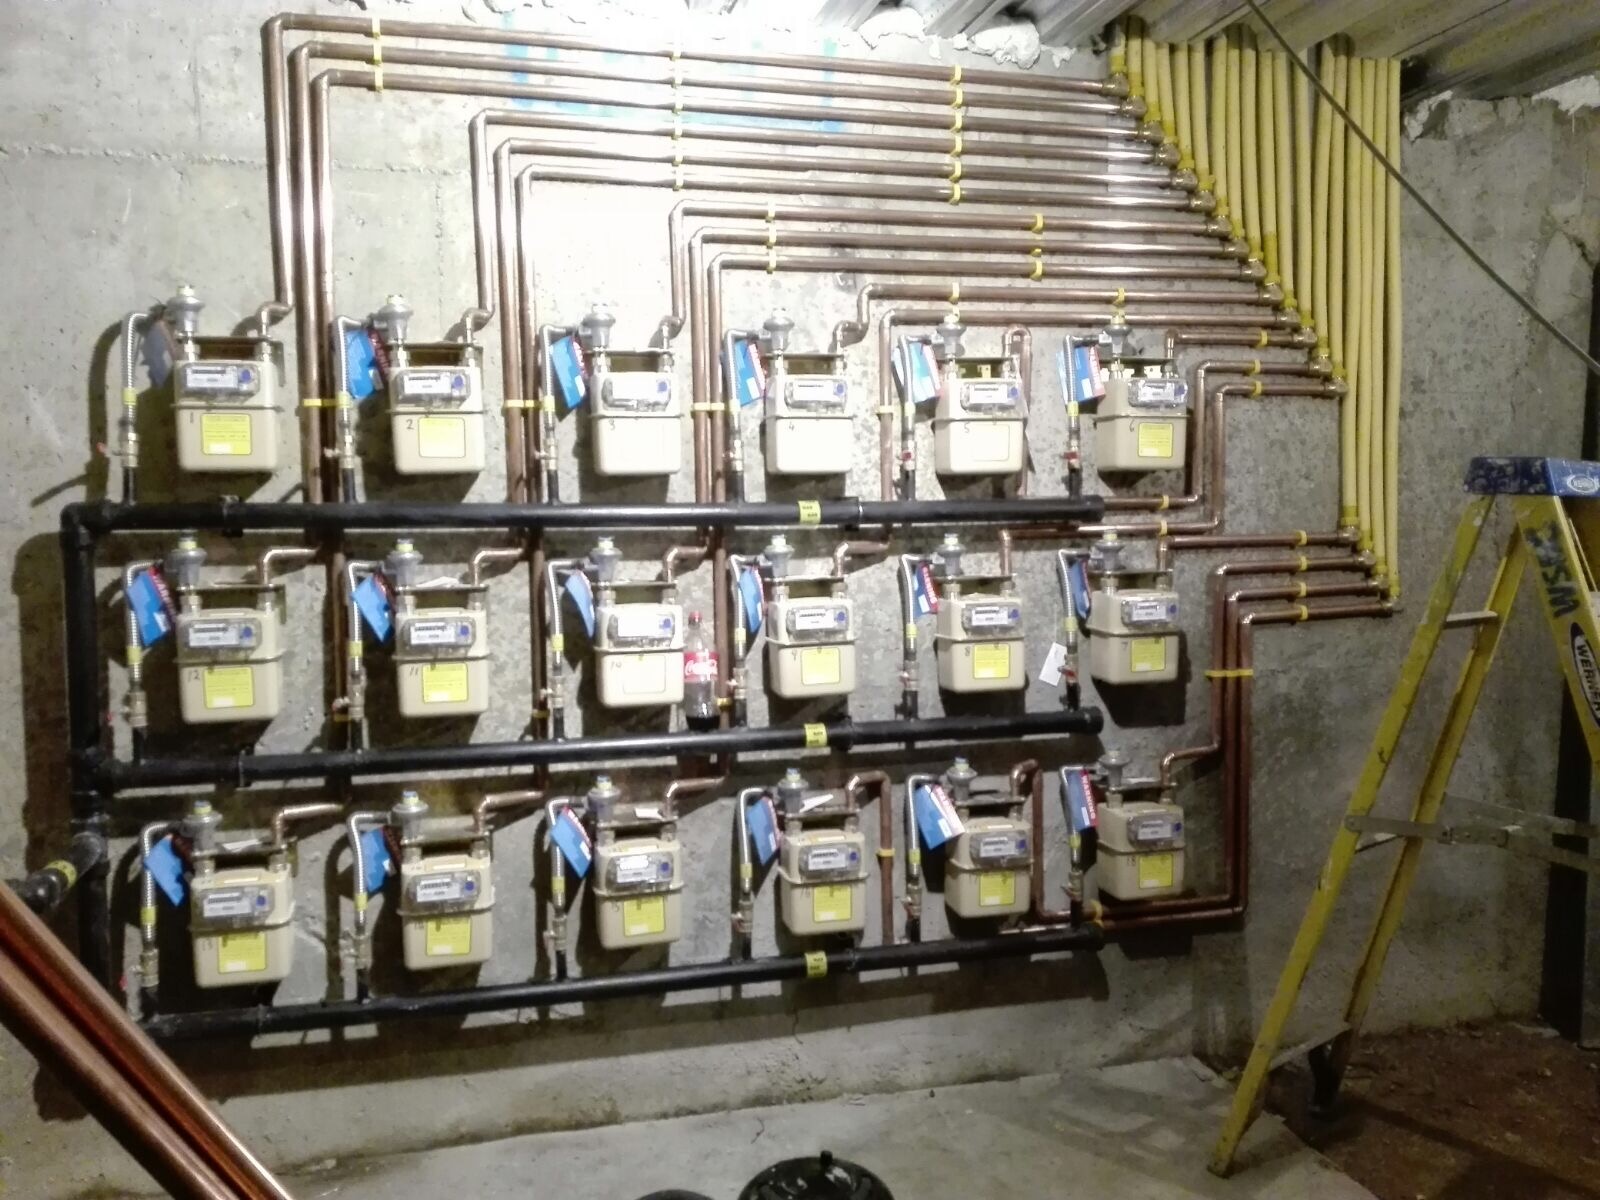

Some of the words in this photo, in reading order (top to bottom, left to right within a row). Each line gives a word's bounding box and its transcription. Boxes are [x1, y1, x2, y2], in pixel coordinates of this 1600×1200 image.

[405, 419, 416, 430] 2
[187, 671, 201, 684] 12
[1081, 774, 1097, 820] WARNING
